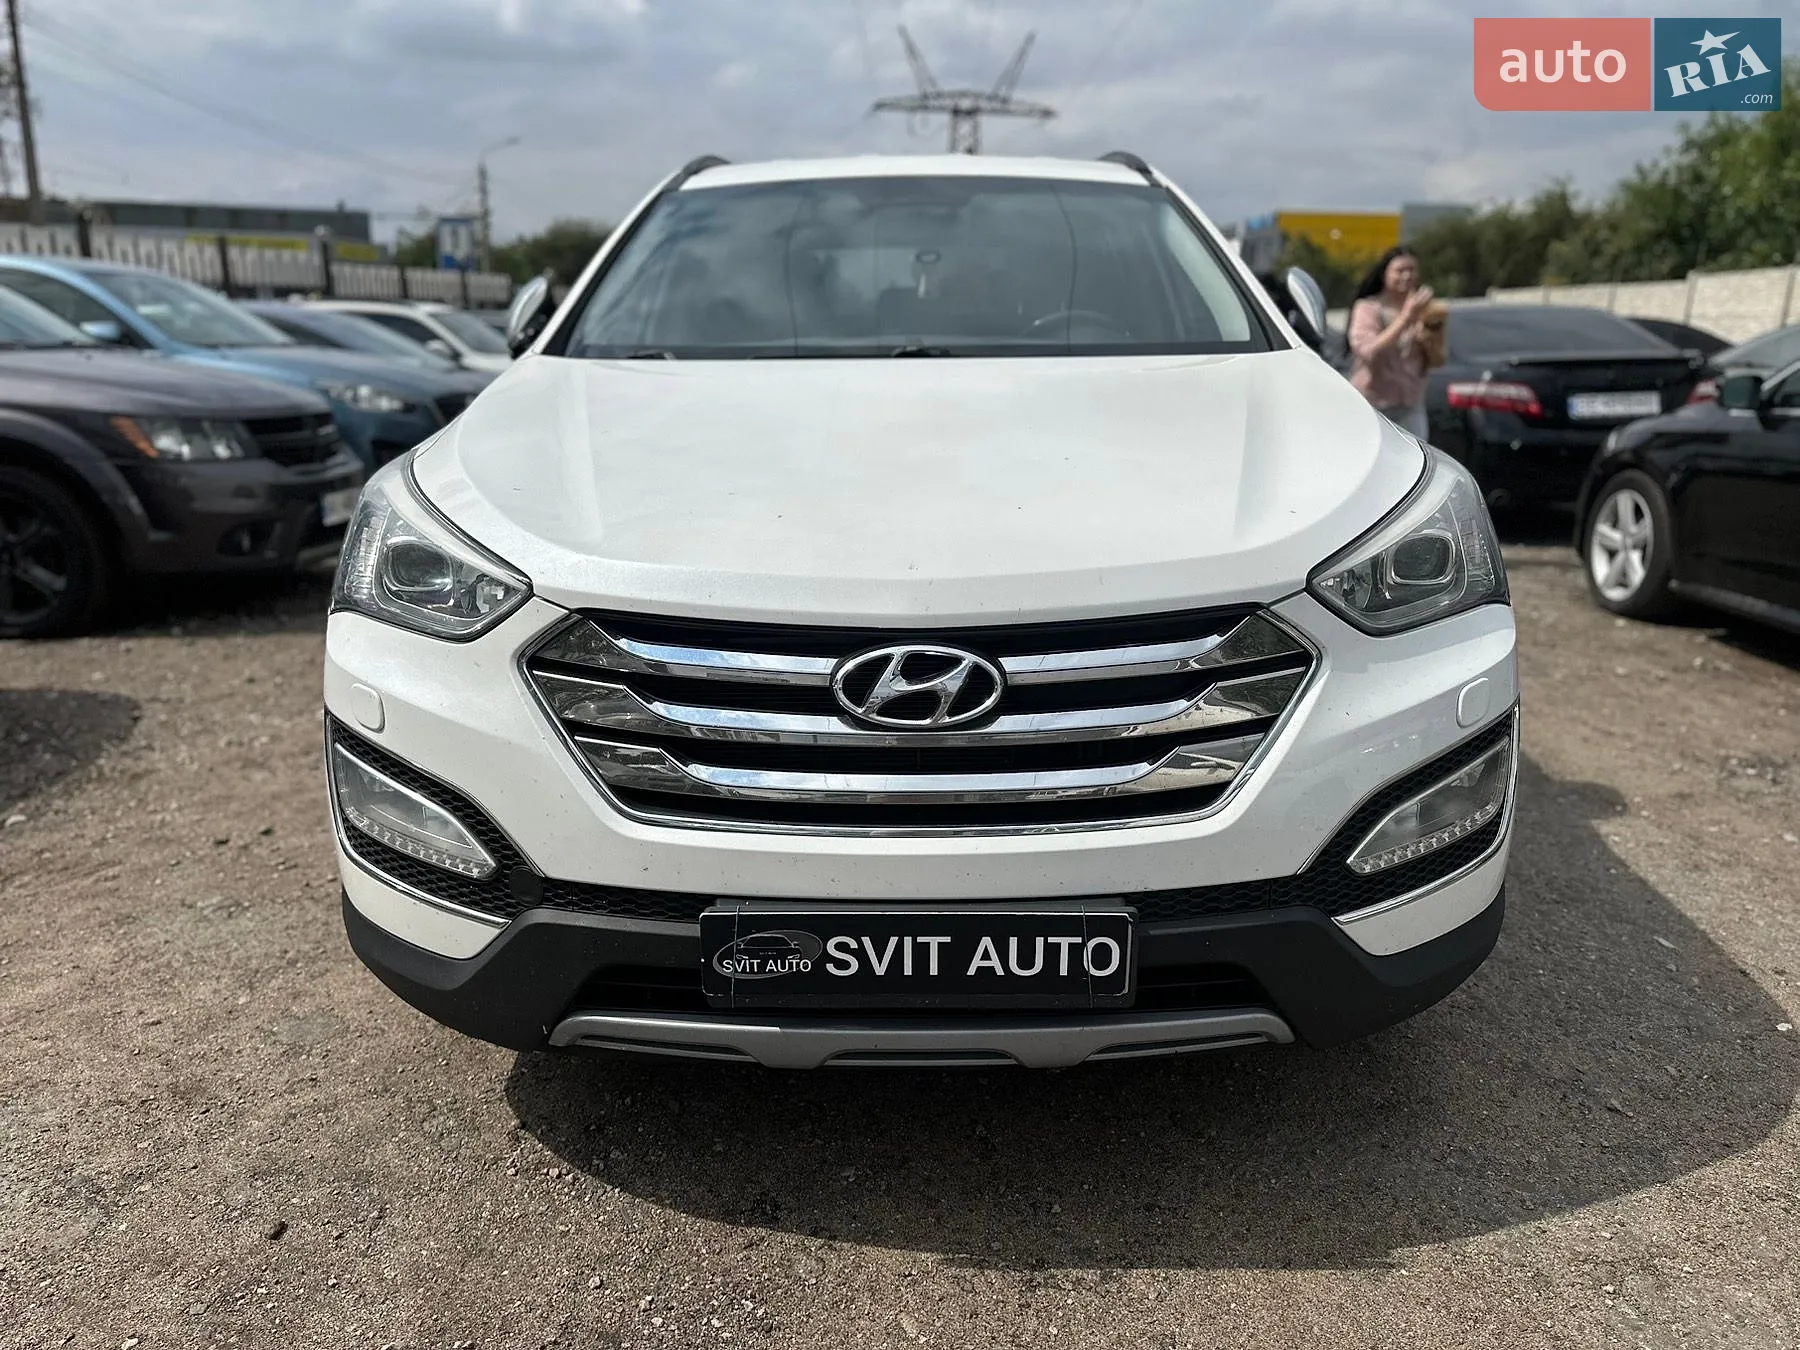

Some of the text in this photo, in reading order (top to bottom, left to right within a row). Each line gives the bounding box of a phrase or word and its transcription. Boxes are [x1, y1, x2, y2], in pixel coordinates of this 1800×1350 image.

[722, 959, 812, 973] SVIT AUTO
[825, 936, 1121, 977] SVIT AUTO
